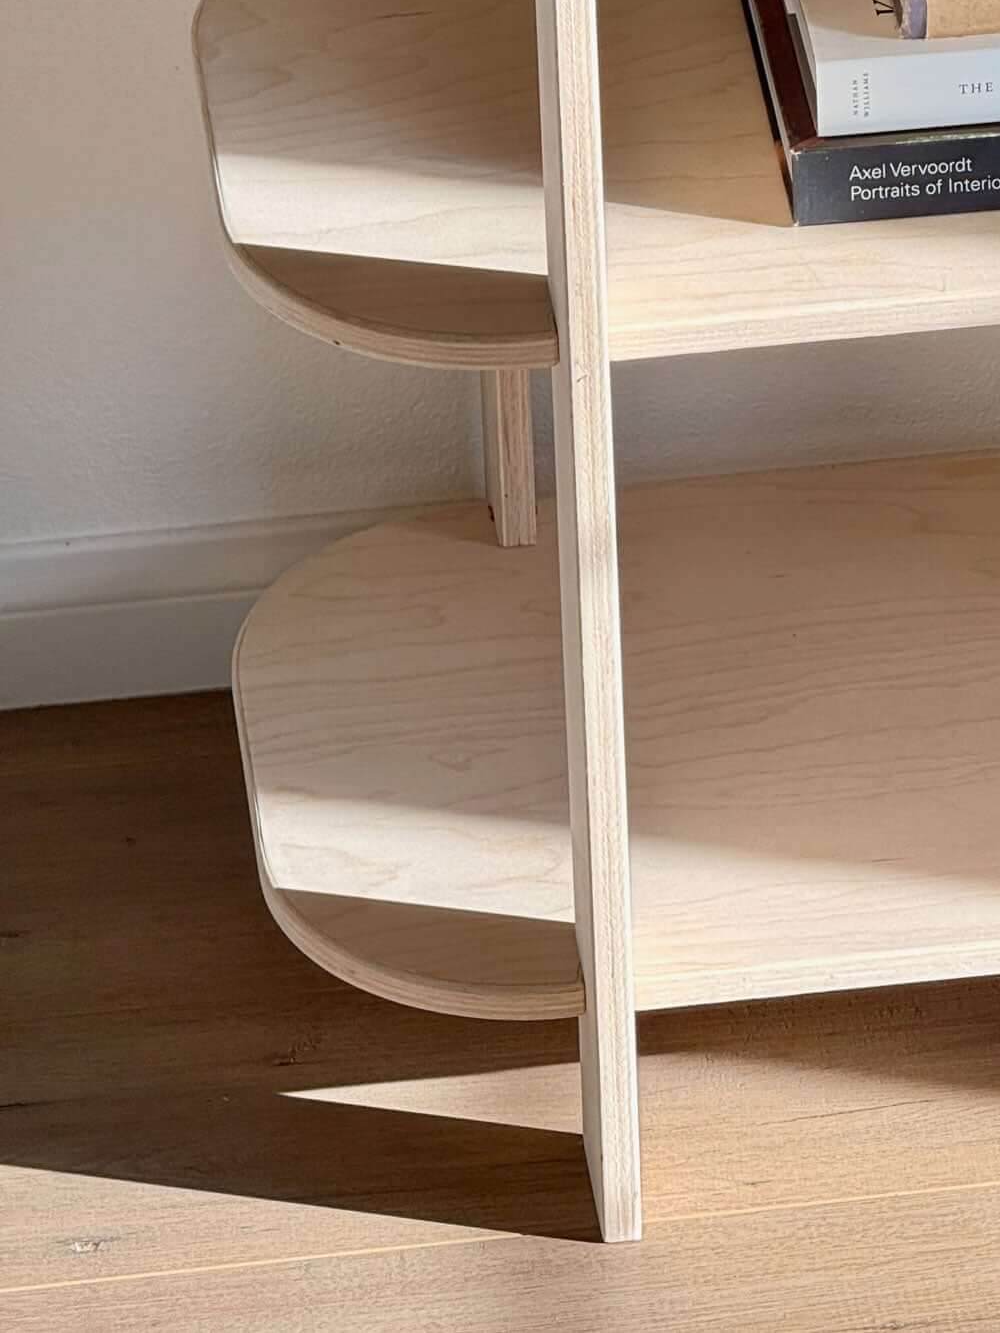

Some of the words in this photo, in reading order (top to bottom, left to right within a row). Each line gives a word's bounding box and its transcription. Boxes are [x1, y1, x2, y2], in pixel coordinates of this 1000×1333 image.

[958, 81, 994, 95] THE
[849, 162, 886, 181] Axel
[889, 157, 973, 178] Vervoordt
[850, 181, 921, 202] Portraits
[925, 178, 943, 196] of
